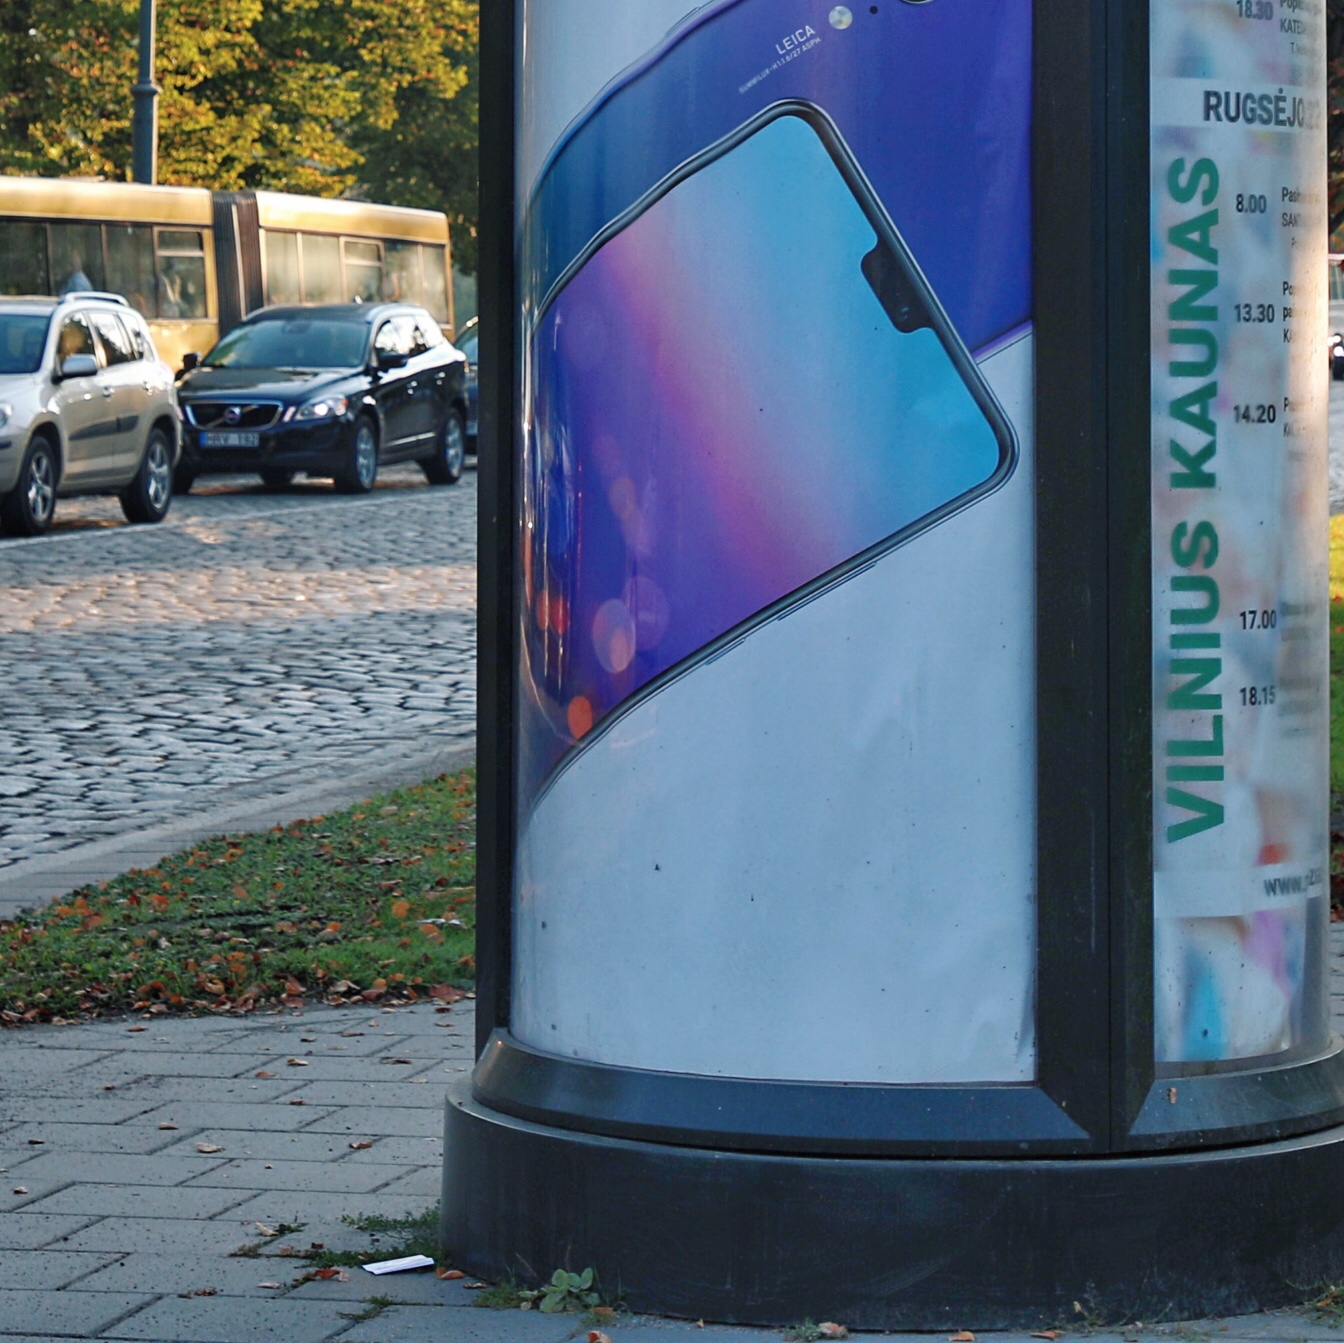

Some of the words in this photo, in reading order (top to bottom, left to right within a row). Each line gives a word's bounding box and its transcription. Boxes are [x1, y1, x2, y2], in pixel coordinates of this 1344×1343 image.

[1236, 0, 1274, 22] 18.30
[775, 25, 816, 55] LEICA
[1203, 87, 1305, 128] RUGSĖJO
[1235, 193, 1268, 215] 8.00
[1168, 158, 1220, 489] KAUNAS
[1234, 303, 1275, 324] 13.30
[1233, 403, 1277, 425] 14.20
[1239, 610, 1278, 630] 17.00
[1167, 519, 1224, 844] VILNIUS
[1239, 687, 1277, 707] 18.15
